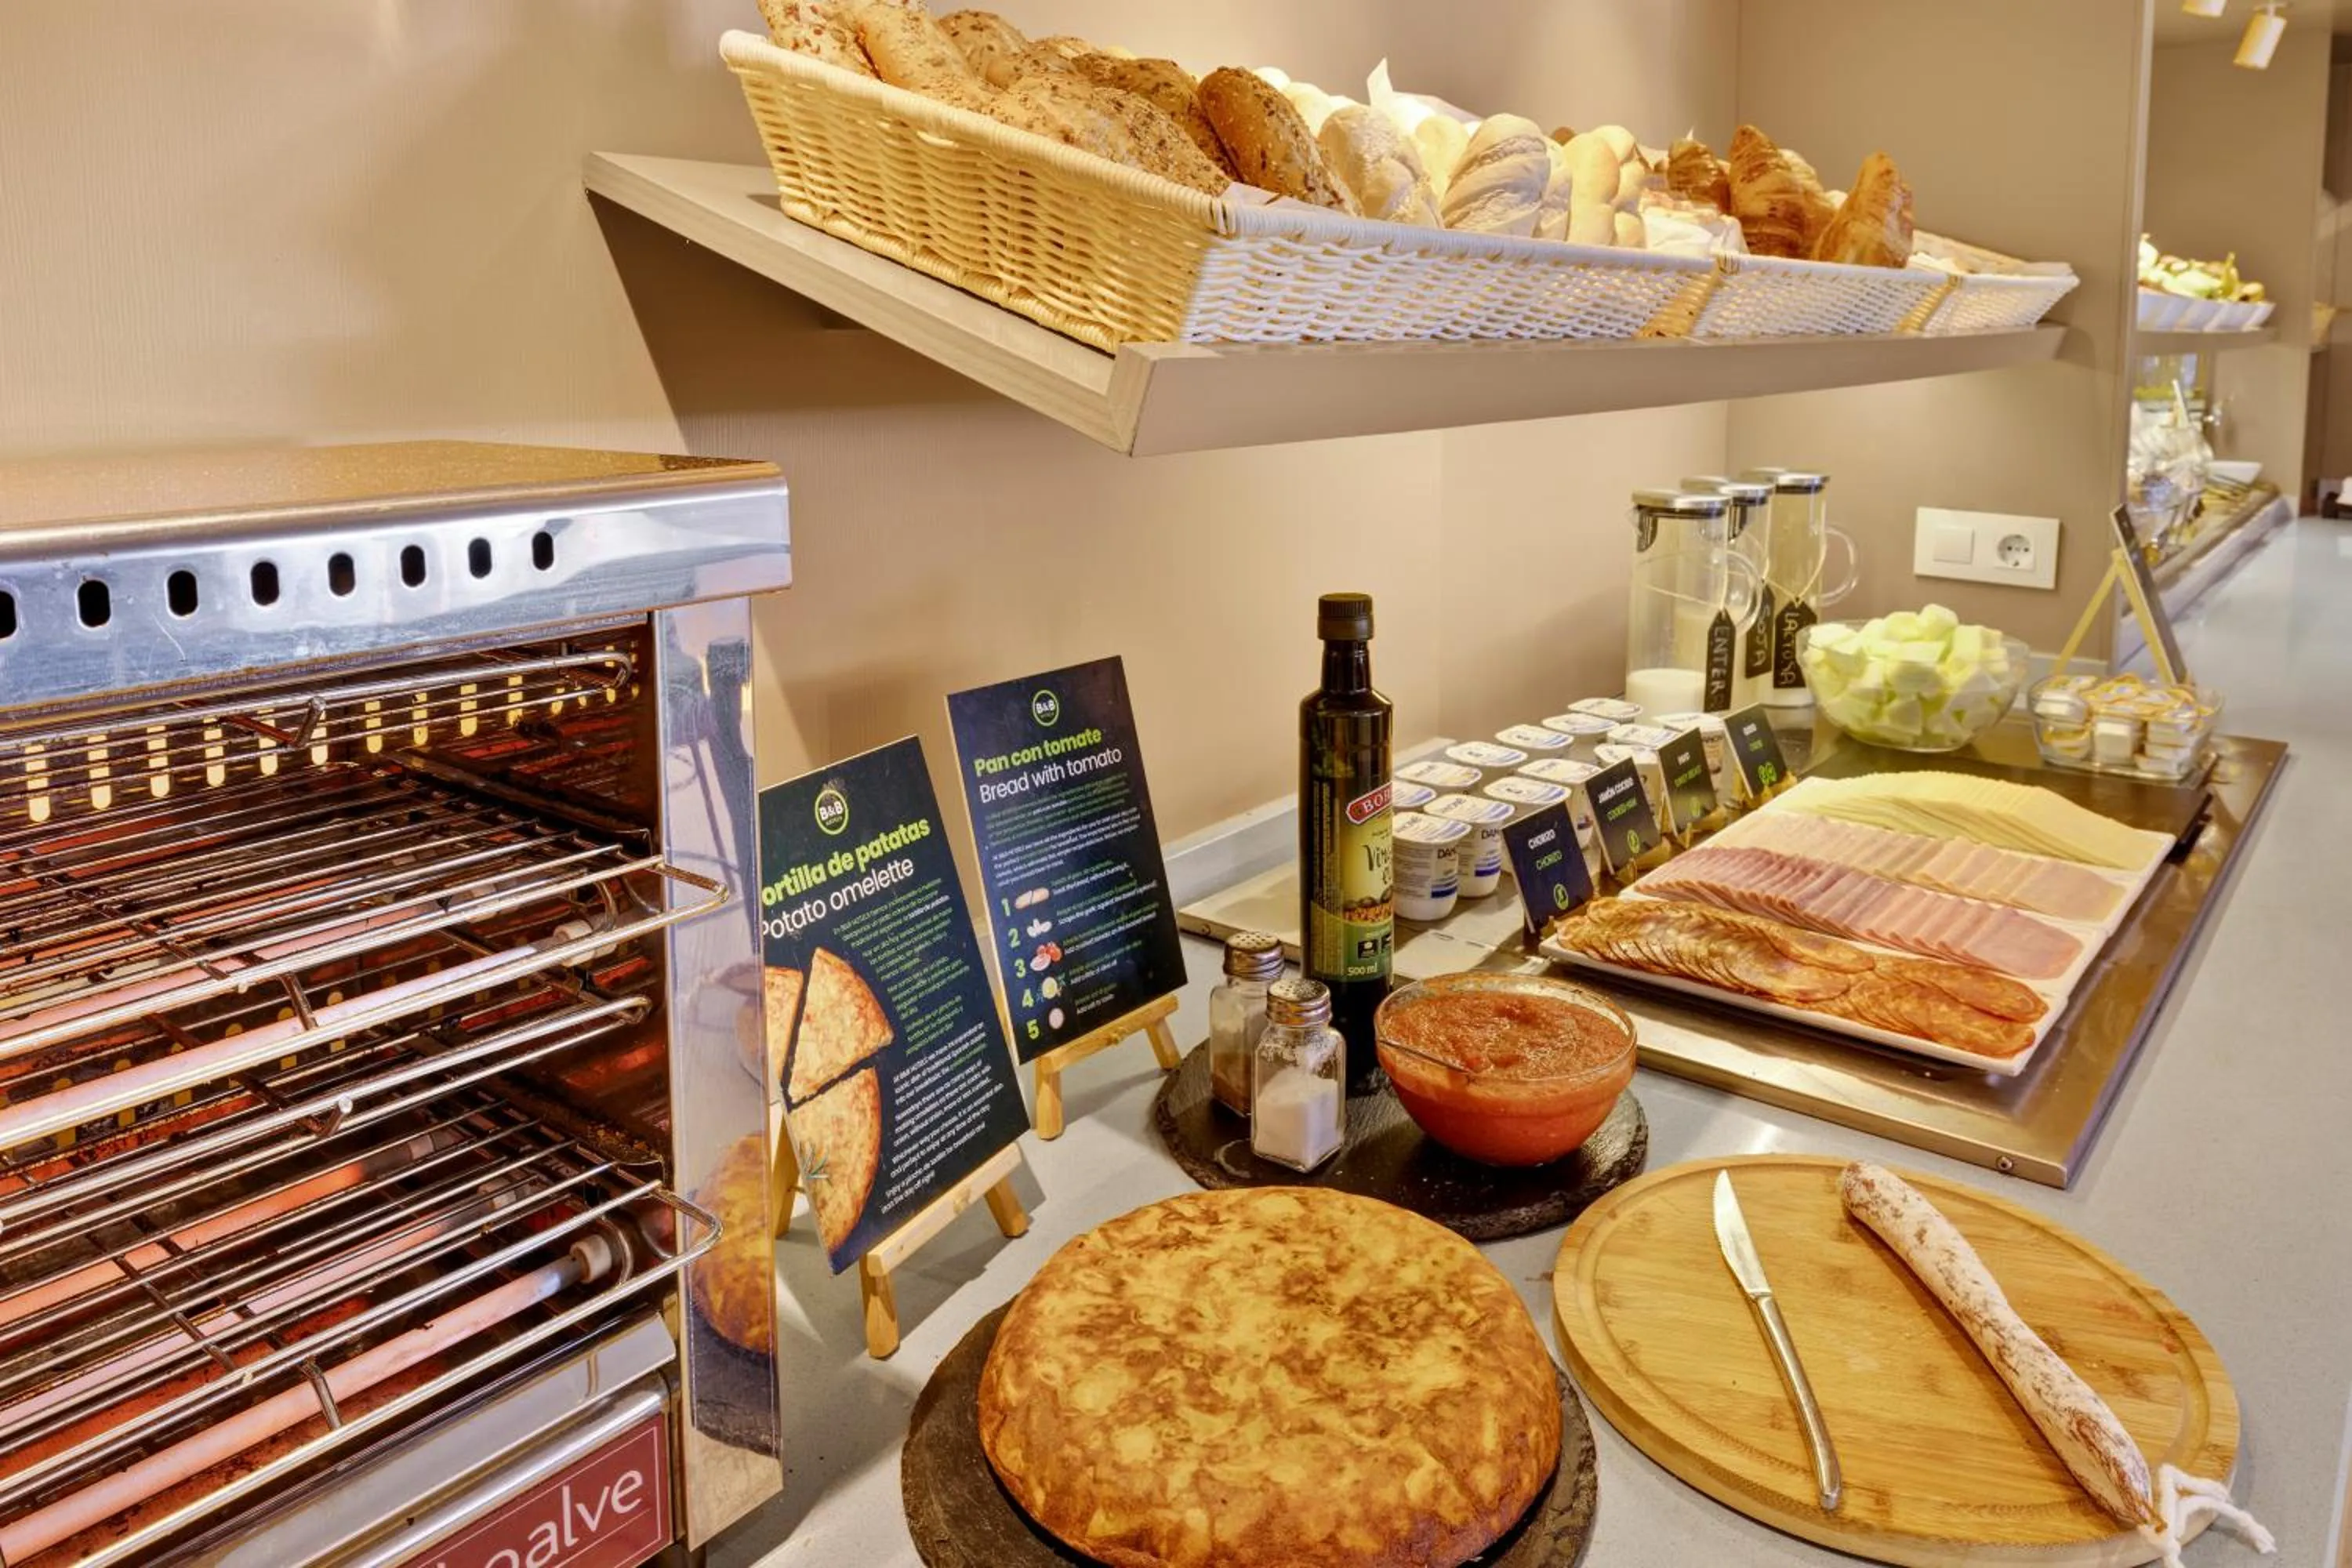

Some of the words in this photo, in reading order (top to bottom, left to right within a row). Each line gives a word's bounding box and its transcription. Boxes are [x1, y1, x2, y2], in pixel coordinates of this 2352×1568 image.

[1710, 626, 1730, 709] ENTER
[974, 756, 1009, 777] Pan
[1011, 746, 1042, 768] con
[1044, 728, 1102, 756] tomate
[980, 771, 1029, 804] Bread
[1032, 762, 1065, 789] with
[1067, 748, 1122, 777] tomato
[819, 800, 844, 821] B&B
[1528, 829, 1555, 850] CHORIZO
[762, 861, 827, 906] ortilla
[828, 851, 854, 878] de
[855, 818, 931, 872] patatas
[829, 858, 914, 911] omelette
[1001, 898, 1011, 916] 1
[1008, 928, 1021, 948] 2
[1014, 959, 1026, 978] 3
[1022, 989, 1034, 1007] 4
[1027, 1019, 1040, 1040] 5
[437, 1470, 643, 1568] alve
